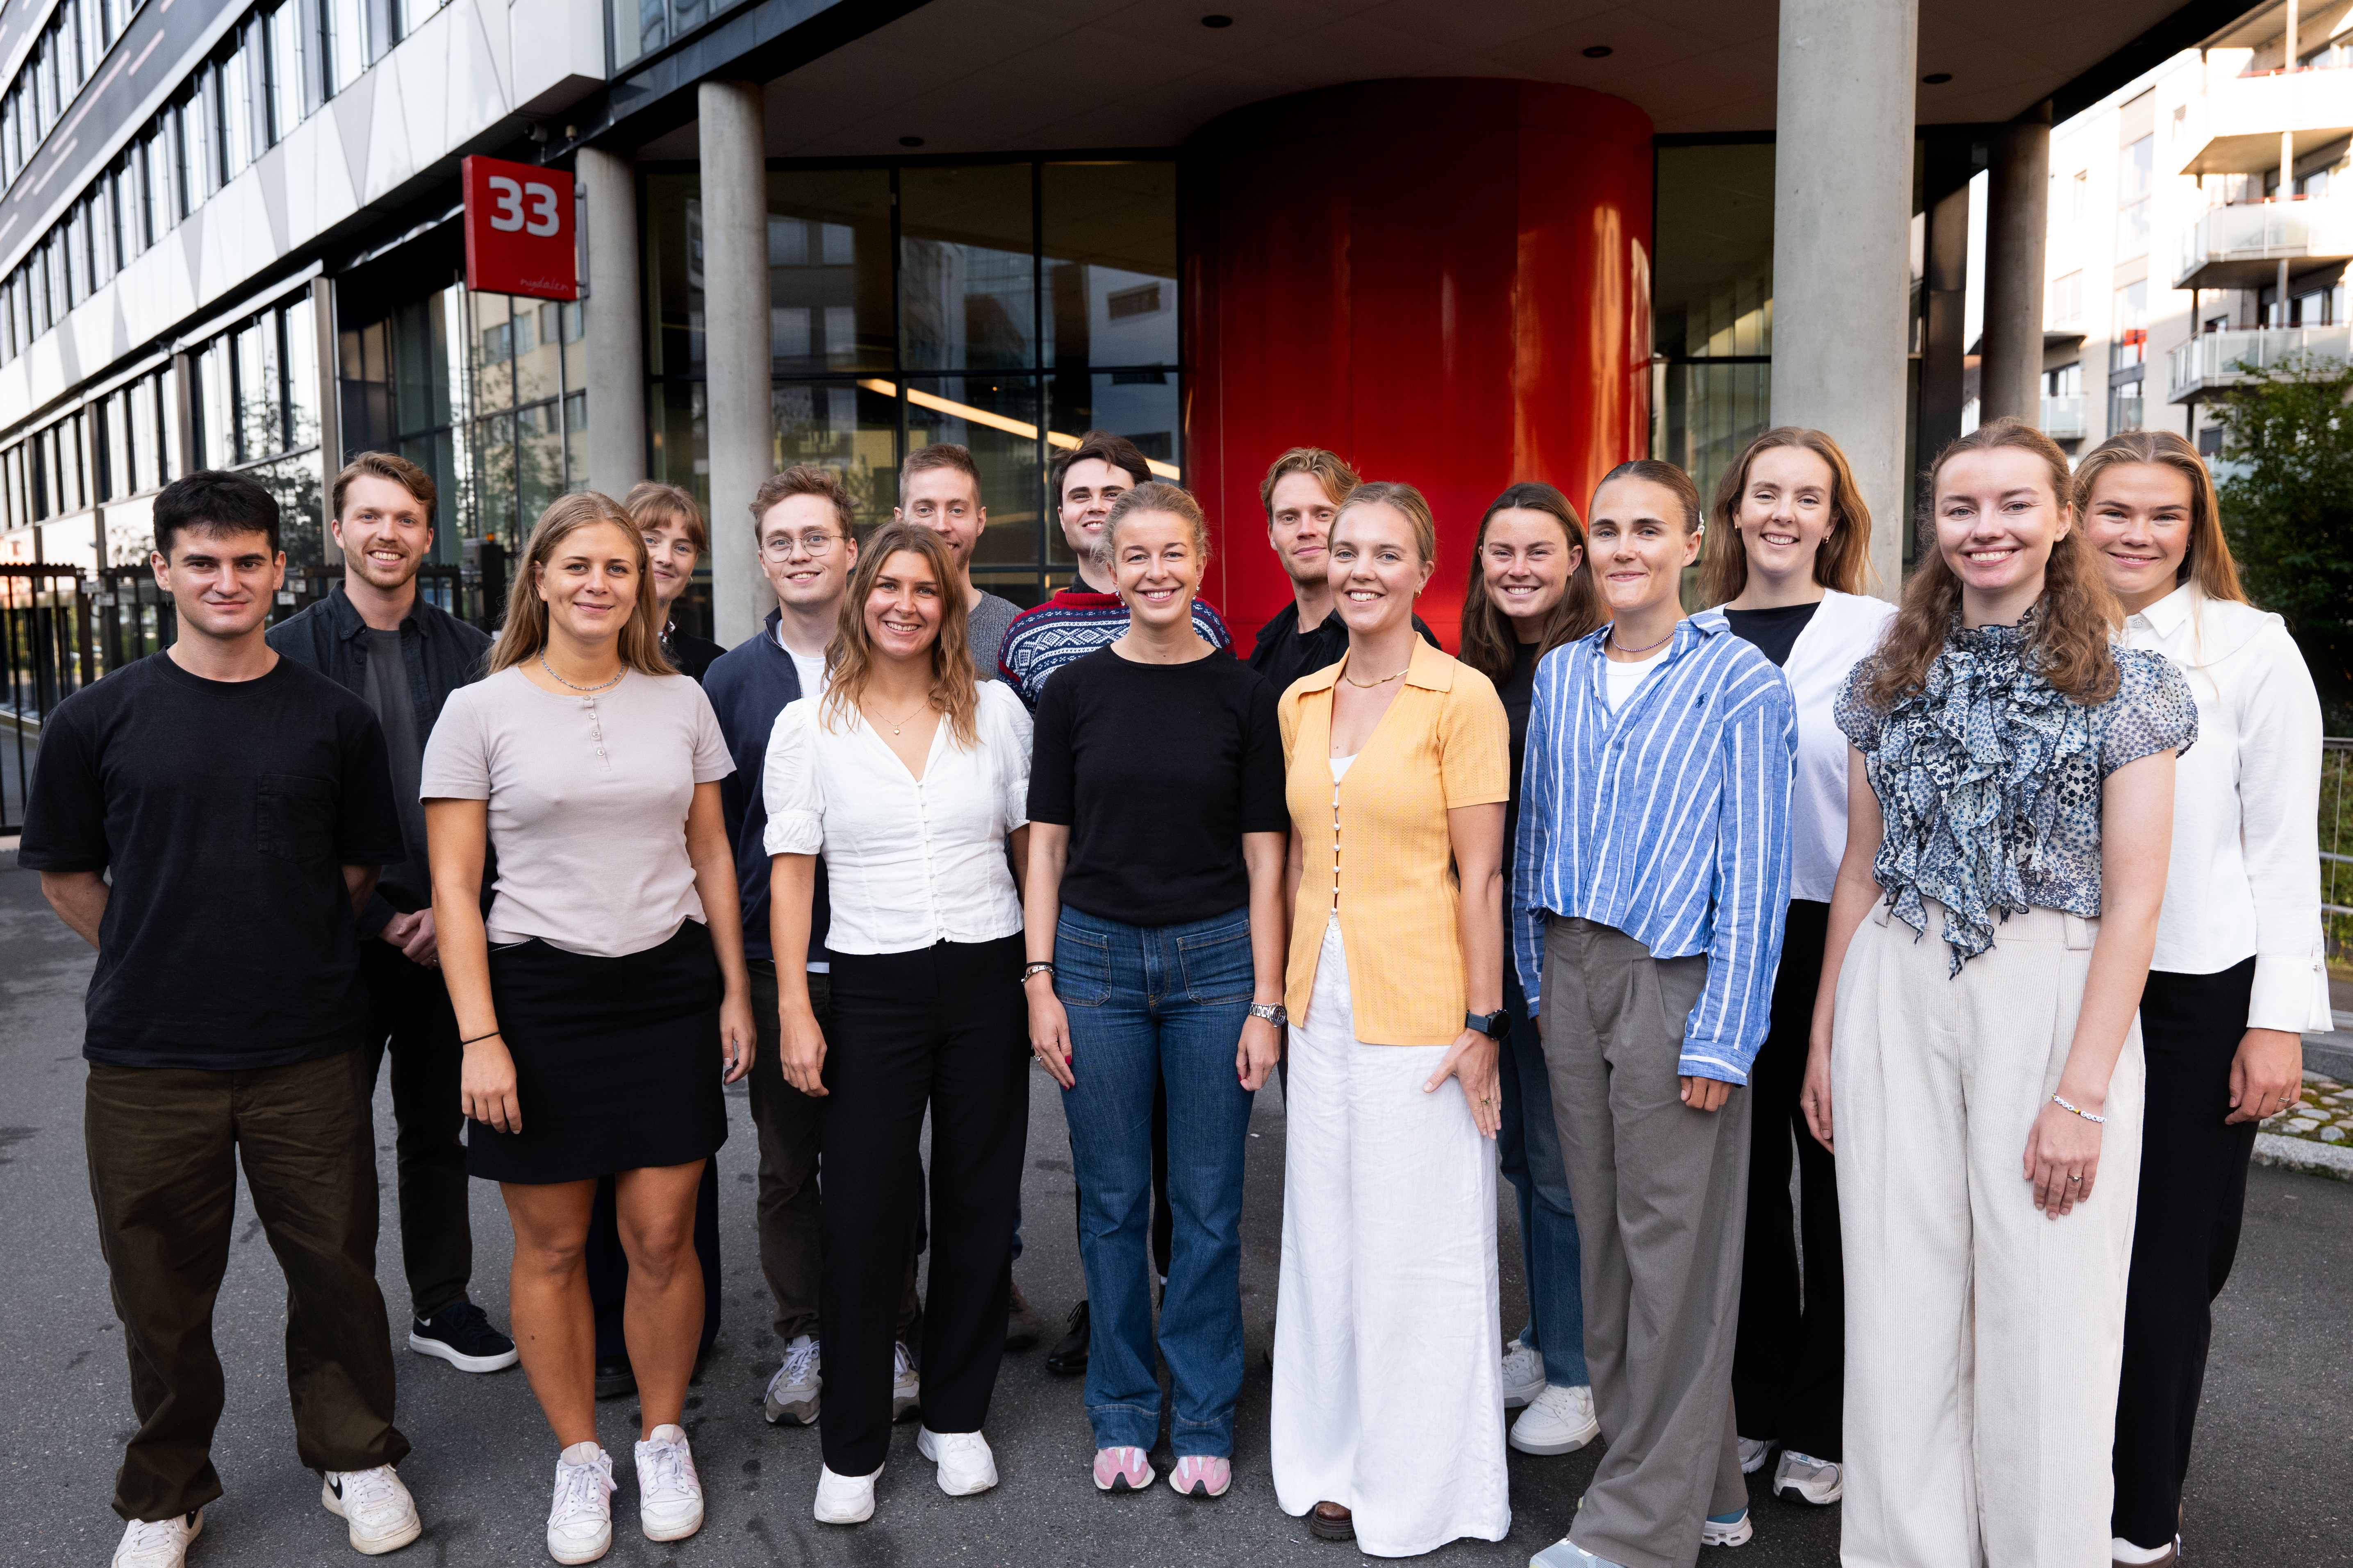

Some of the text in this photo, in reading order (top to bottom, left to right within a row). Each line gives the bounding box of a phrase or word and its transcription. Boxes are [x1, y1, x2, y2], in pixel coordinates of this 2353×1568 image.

[489, 175, 560, 237] 33
[2054, 1096, 2105, 1123] FUCK CANCE
